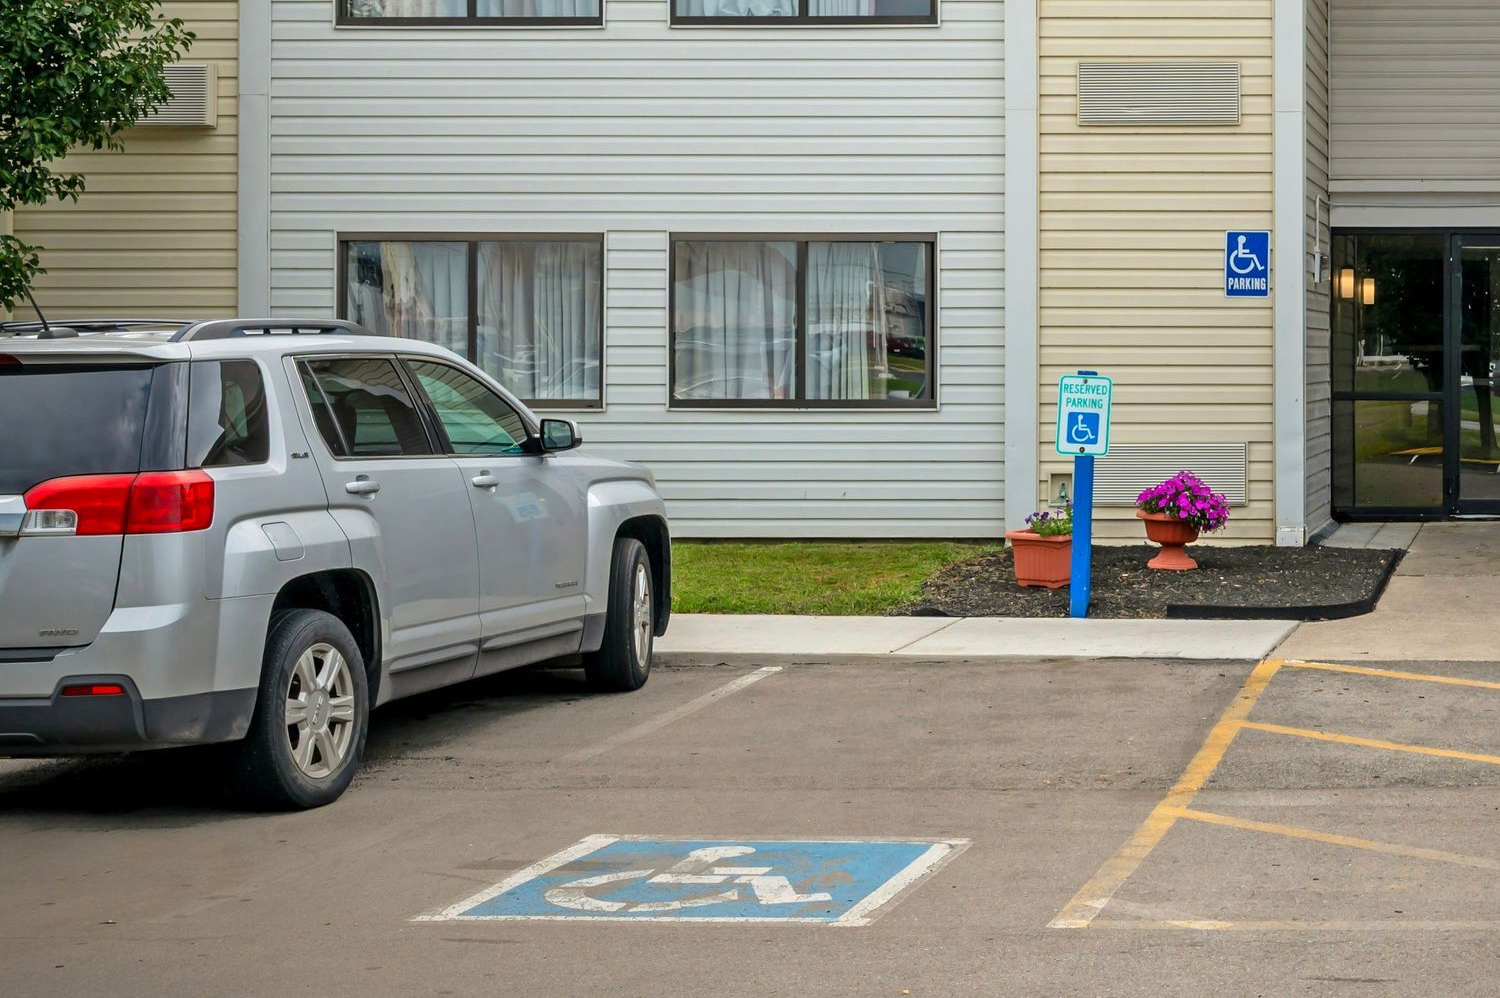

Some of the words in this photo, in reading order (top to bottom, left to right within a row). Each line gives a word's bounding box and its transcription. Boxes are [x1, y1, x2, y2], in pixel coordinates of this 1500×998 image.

[1228, 278, 1266, 290] PARKING
[1064, 384, 1108, 395] RESERVED
[1066, 397, 1103, 409] PARKING
